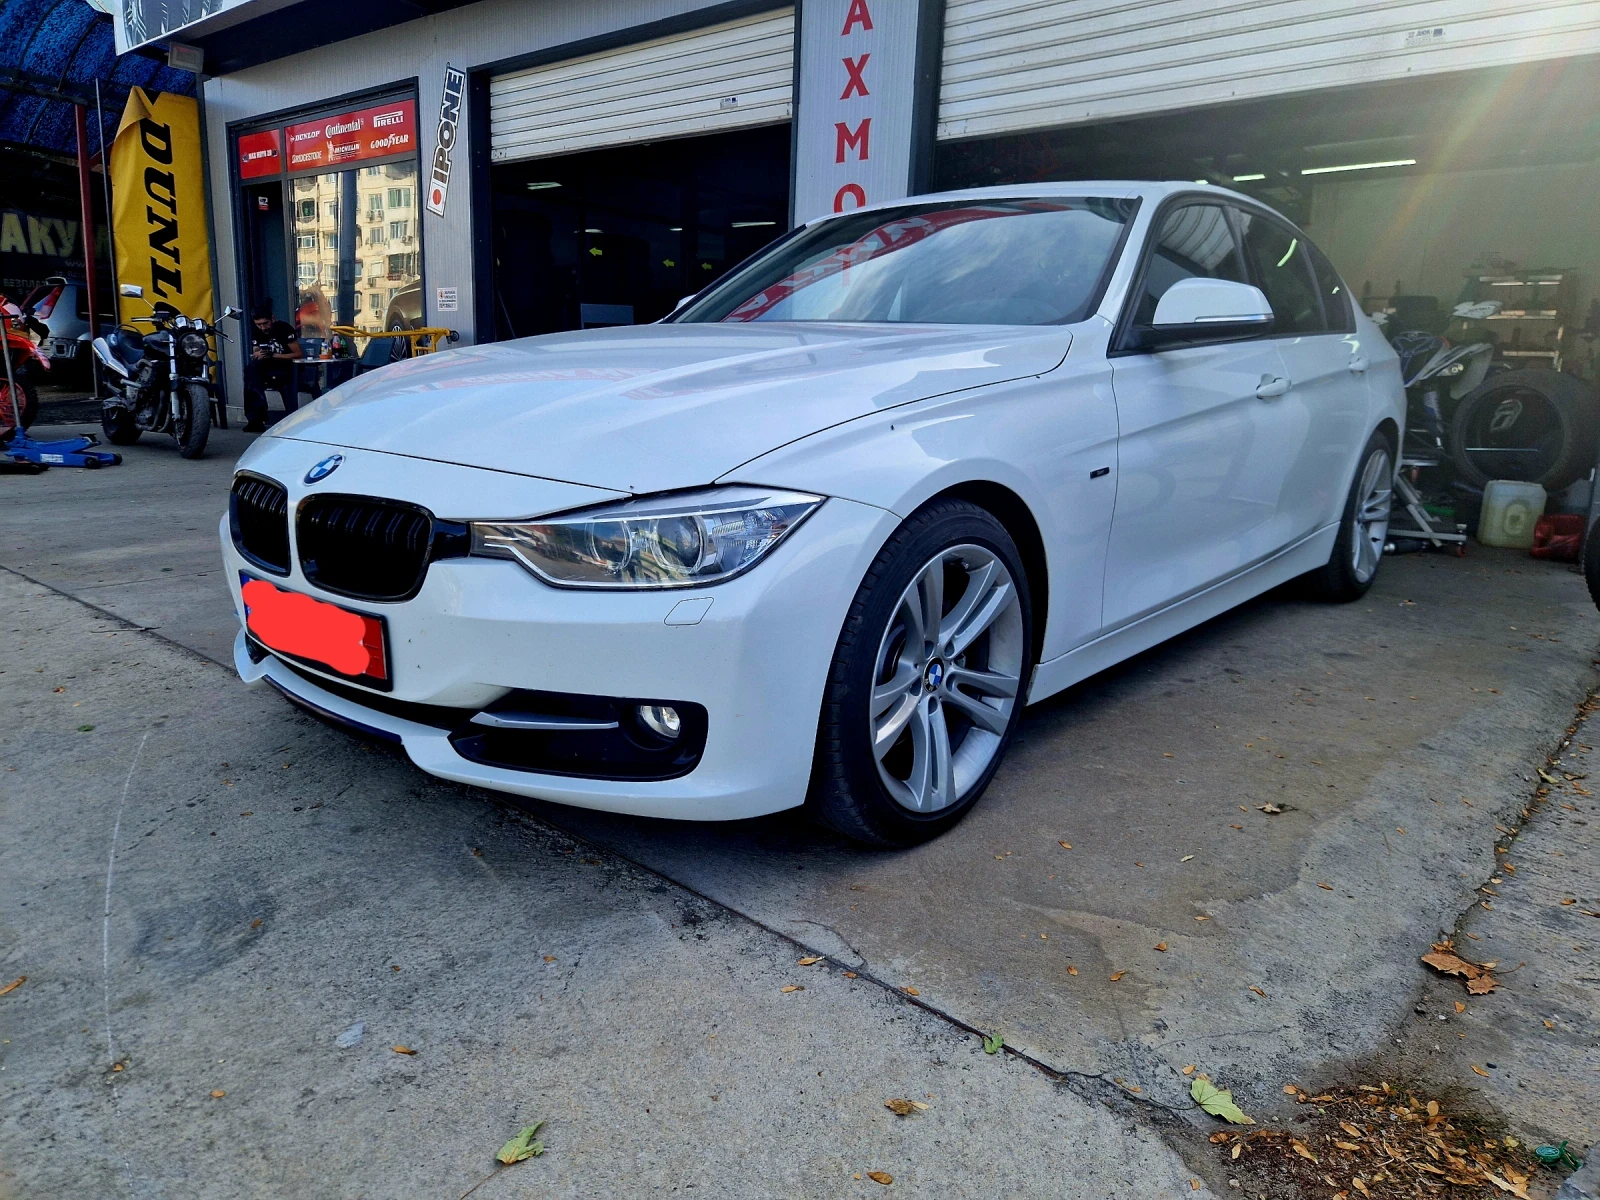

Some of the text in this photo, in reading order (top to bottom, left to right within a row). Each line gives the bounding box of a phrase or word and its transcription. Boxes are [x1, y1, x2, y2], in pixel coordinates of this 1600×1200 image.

[325, 118, 361, 138] Continental
[373, 110, 404, 128] PIRELLI
[432, 69, 465, 184] IPONE
[294, 130, 321, 142] DUNLOP
[291, 150, 322, 164] BRIDGESTONE
